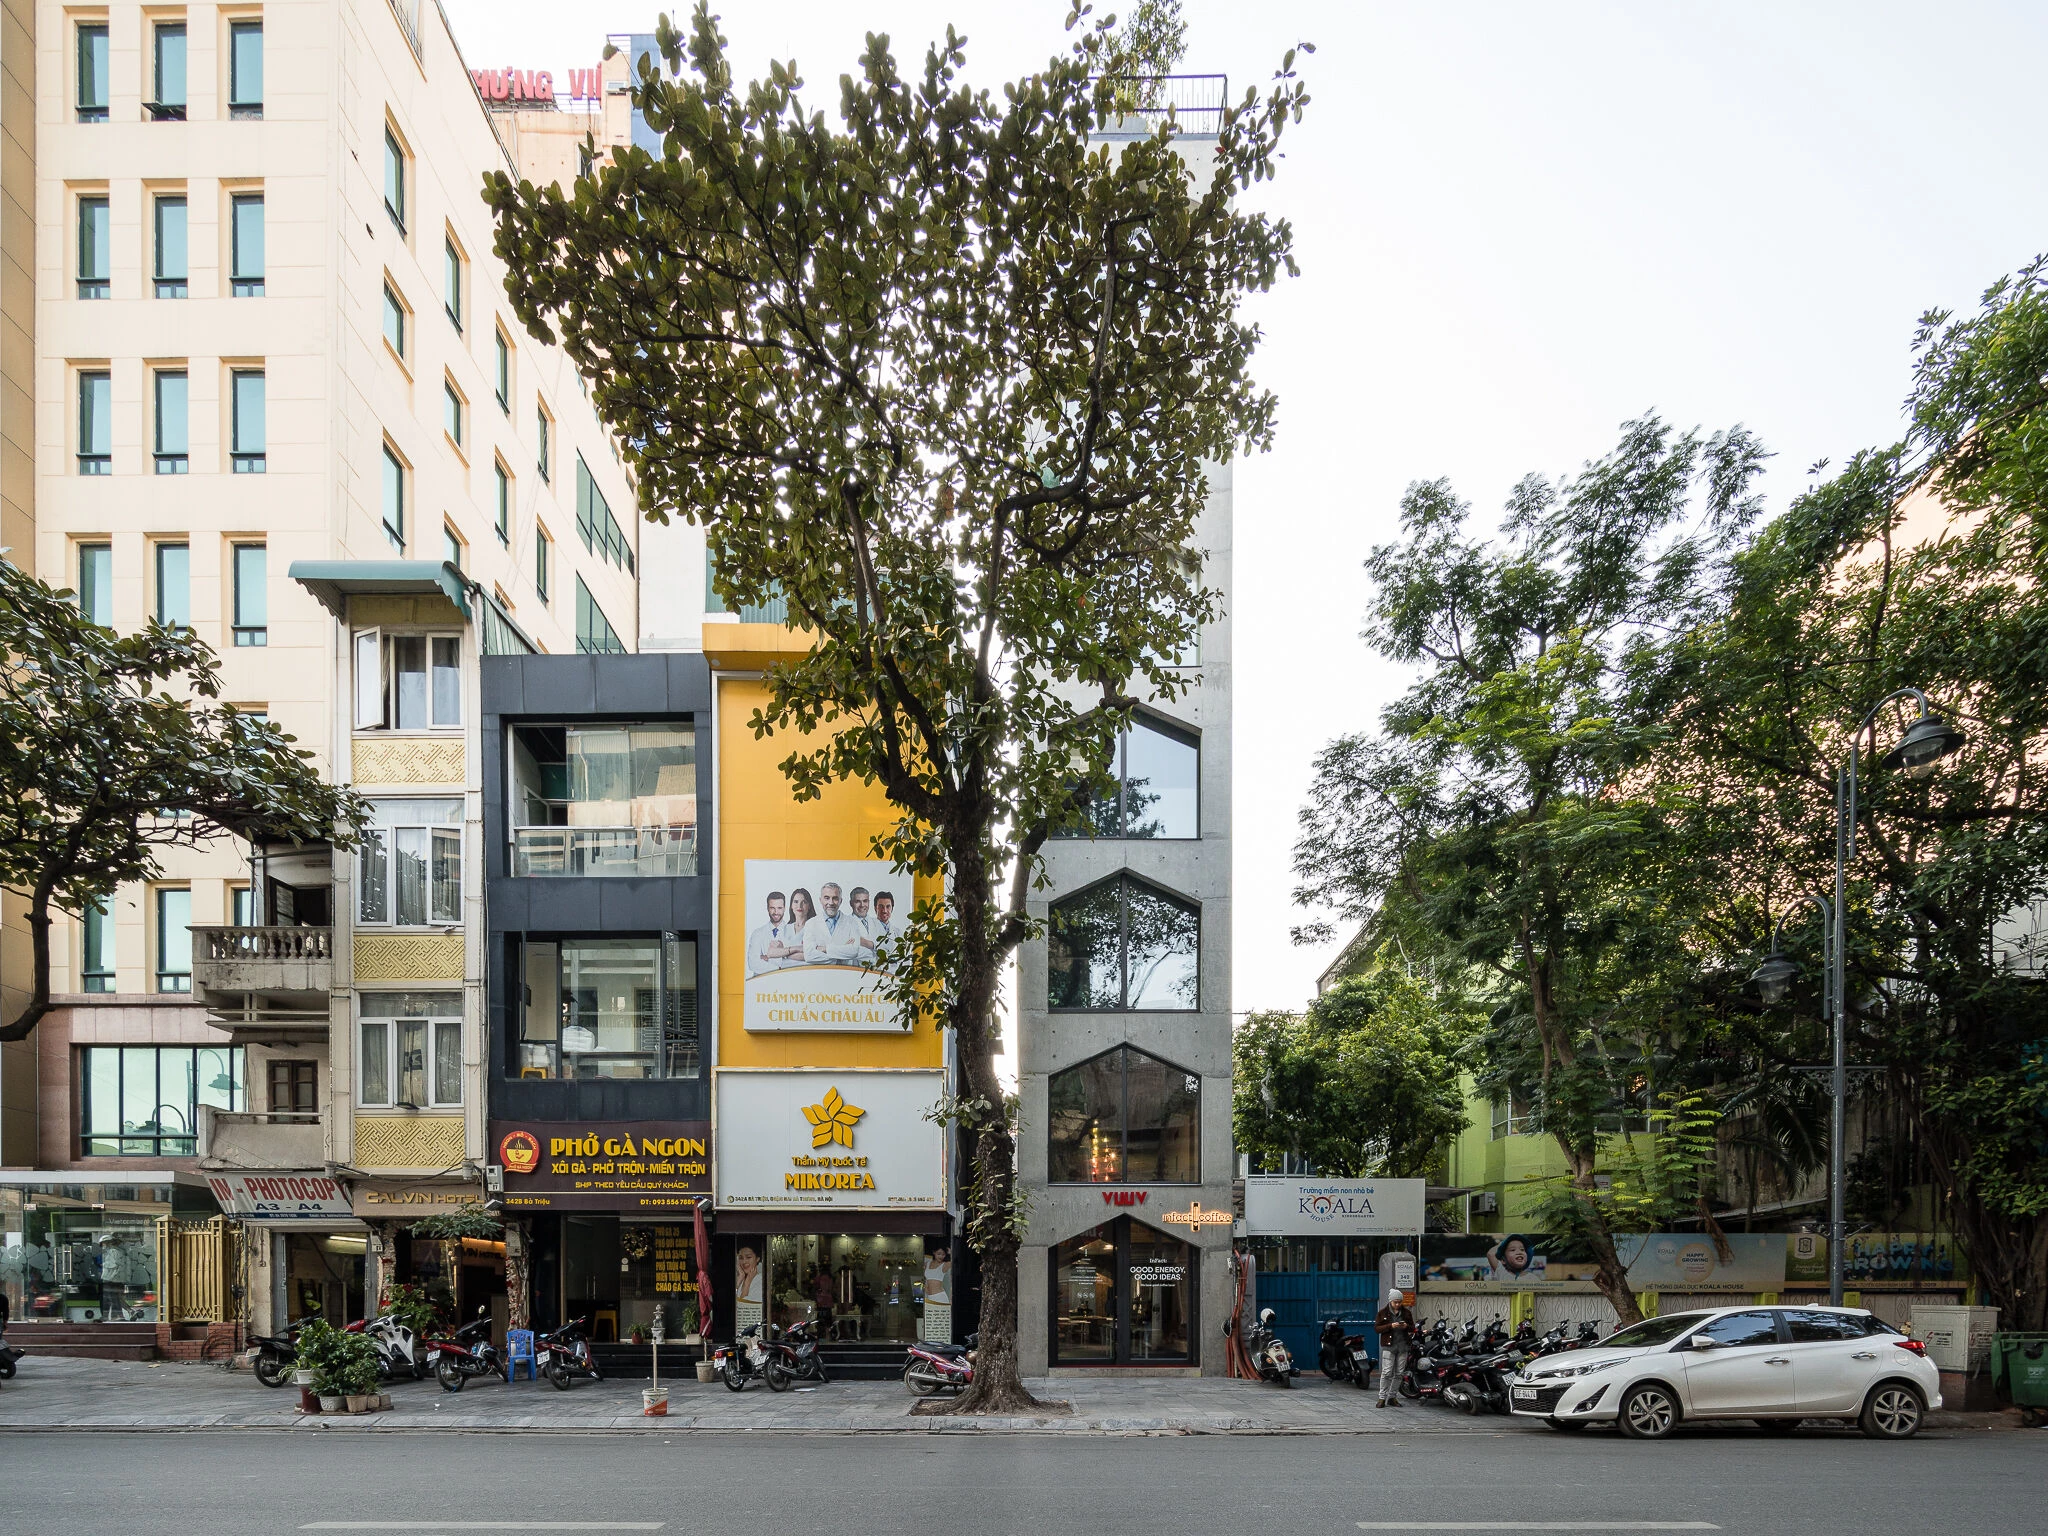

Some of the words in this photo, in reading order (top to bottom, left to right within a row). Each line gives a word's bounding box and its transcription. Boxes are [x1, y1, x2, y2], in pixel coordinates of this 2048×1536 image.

[807, 992, 842, 1004] CÔNG
[821, 1008, 862, 1022] CHÂU
[864, 1008, 885, 1022] ÂU
[550, 1132, 600, 1157] PHỞ
[603, 1132, 638, 1157] GÀ
[642, 1137, 706, 1157] NGON
[551, 1160, 569, 1174] XÔI
[571, 1160, 587, 1174] GÀ
[592, 1159, 615, 1174] PHỞ
[616, 1160, 645, 1176] TRỘN
[649, 1159, 675, 1174] MIẾN
[677, 1161, 706, 1177] TRỘN
[594, 1181, 614, 1189] THEO
[784, 1172, 875, 1190] MIKOREA
[243, 1177, 348, 1201] PHOTOCOPY
[366, 1192, 433, 1204] CALVIN
[1298, 1195, 1375, 1214] KOALA
[255, 1203, 280, 1211] A3
[298, 1203, 323, 1211] A4
[1154, 1266, 1186, 1274] ENERGY,
[1134, 1273, 1158, 1281] GOOD
[1159, 1273, 1183, 1281] IDEAS.
